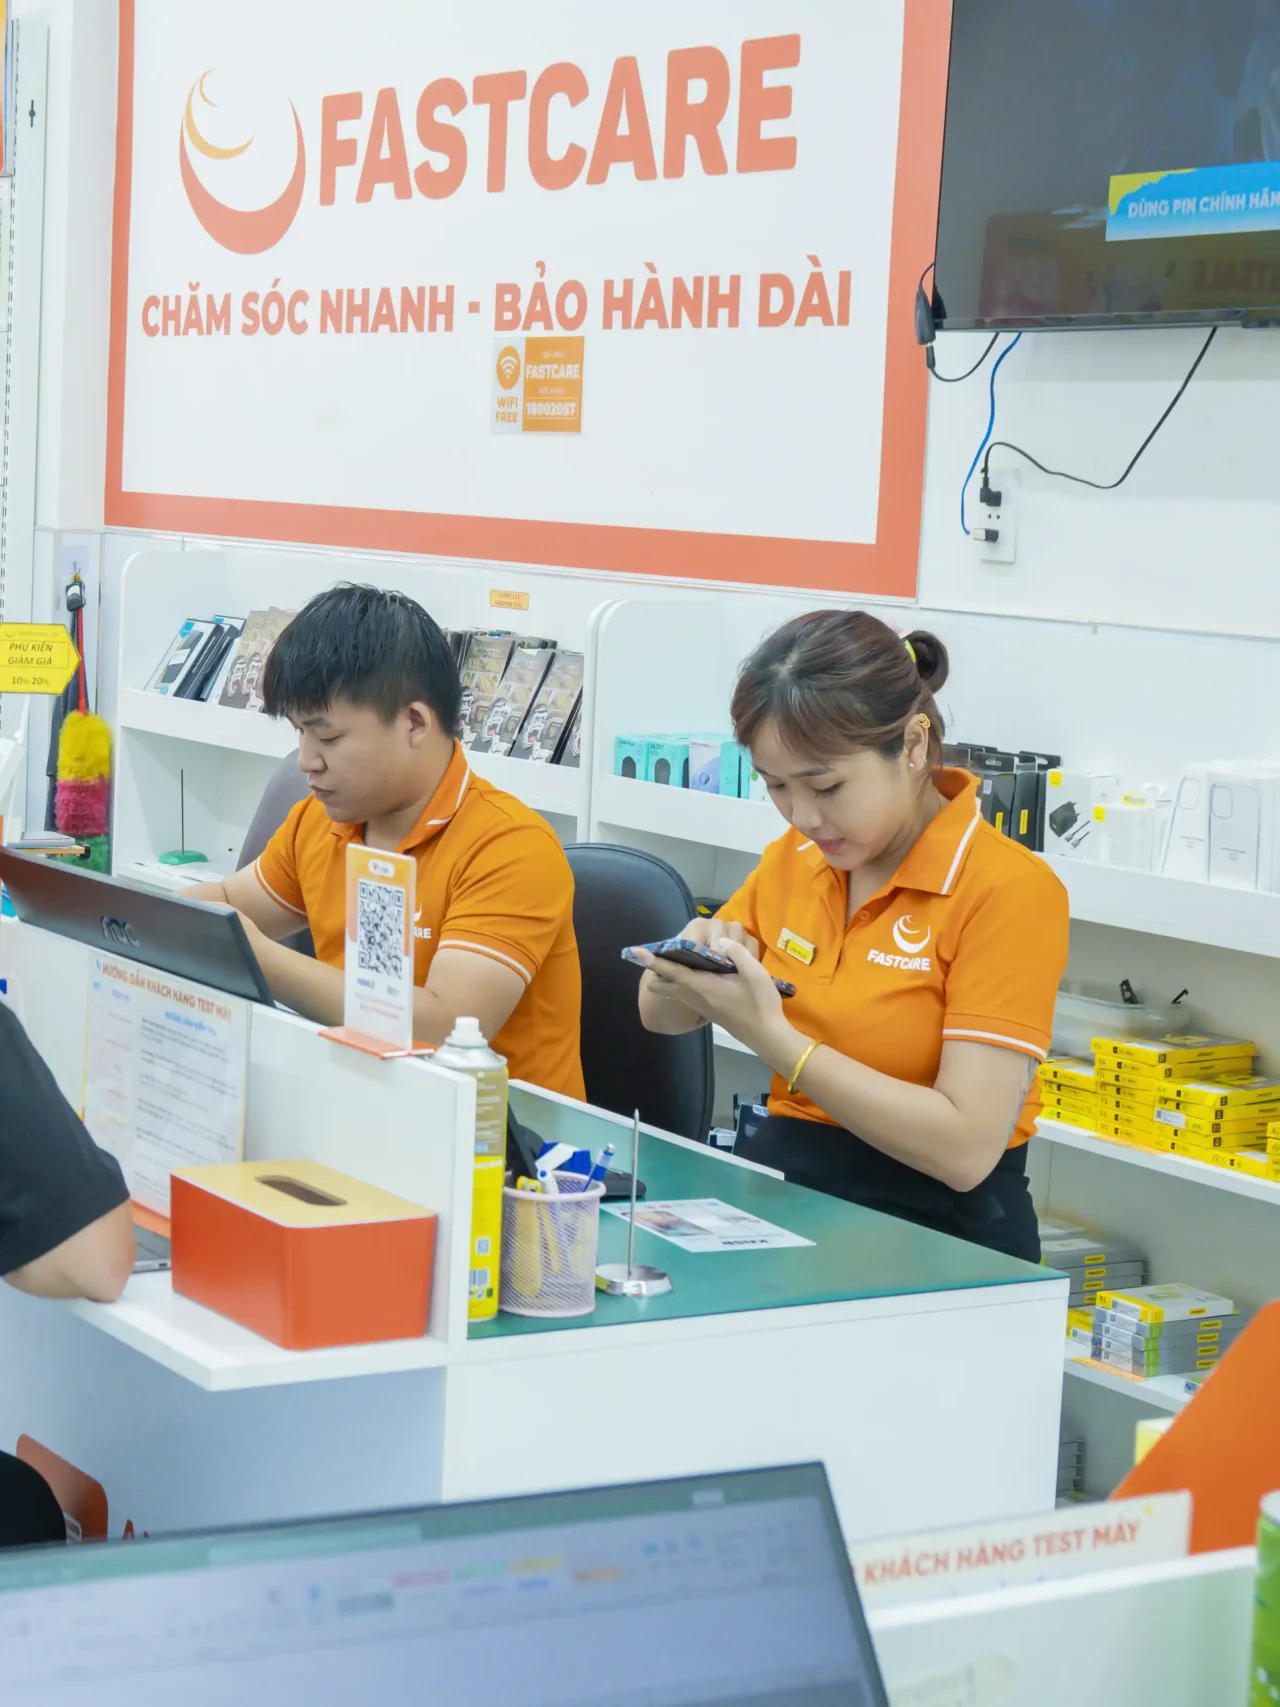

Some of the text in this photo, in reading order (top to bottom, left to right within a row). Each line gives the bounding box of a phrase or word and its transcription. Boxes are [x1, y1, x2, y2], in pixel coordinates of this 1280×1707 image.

[319, 33, 801, 207] FASTCARE
[1128, 198, 1170, 218] DÙNG
[1173, 197, 1196, 215] PIN
[1199, 190, 1246, 212] CHÍNH
[141, 282, 231, 338] CHĂM
[241, 278, 309, 335] SÓC
[320, 285, 455, 334] NHANH
[494, 260, 588, 332] BẢO
[603, 262, 740, 331] HÀNH
[758, 254, 851, 328] DÀI
[525, 364, 580, 379] FASTCARE
[497, 396, 518, 408] WIFI
[495, 412, 518, 423] FREE
[9, 641, 53, 653] PHỤ KIỆN
[8, 654, 52, 665] GIẢM GIÁ
[867, 949, 931, 971] FASTCARE
[146, 979, 171, 998] KHÁCH
[173, 989, 195, 1008] HÀNG
[197, 997, 214, 1014] TEST
[864, 1514, 1141, 1587] KHÁCH HÀNG TEST MÁY
